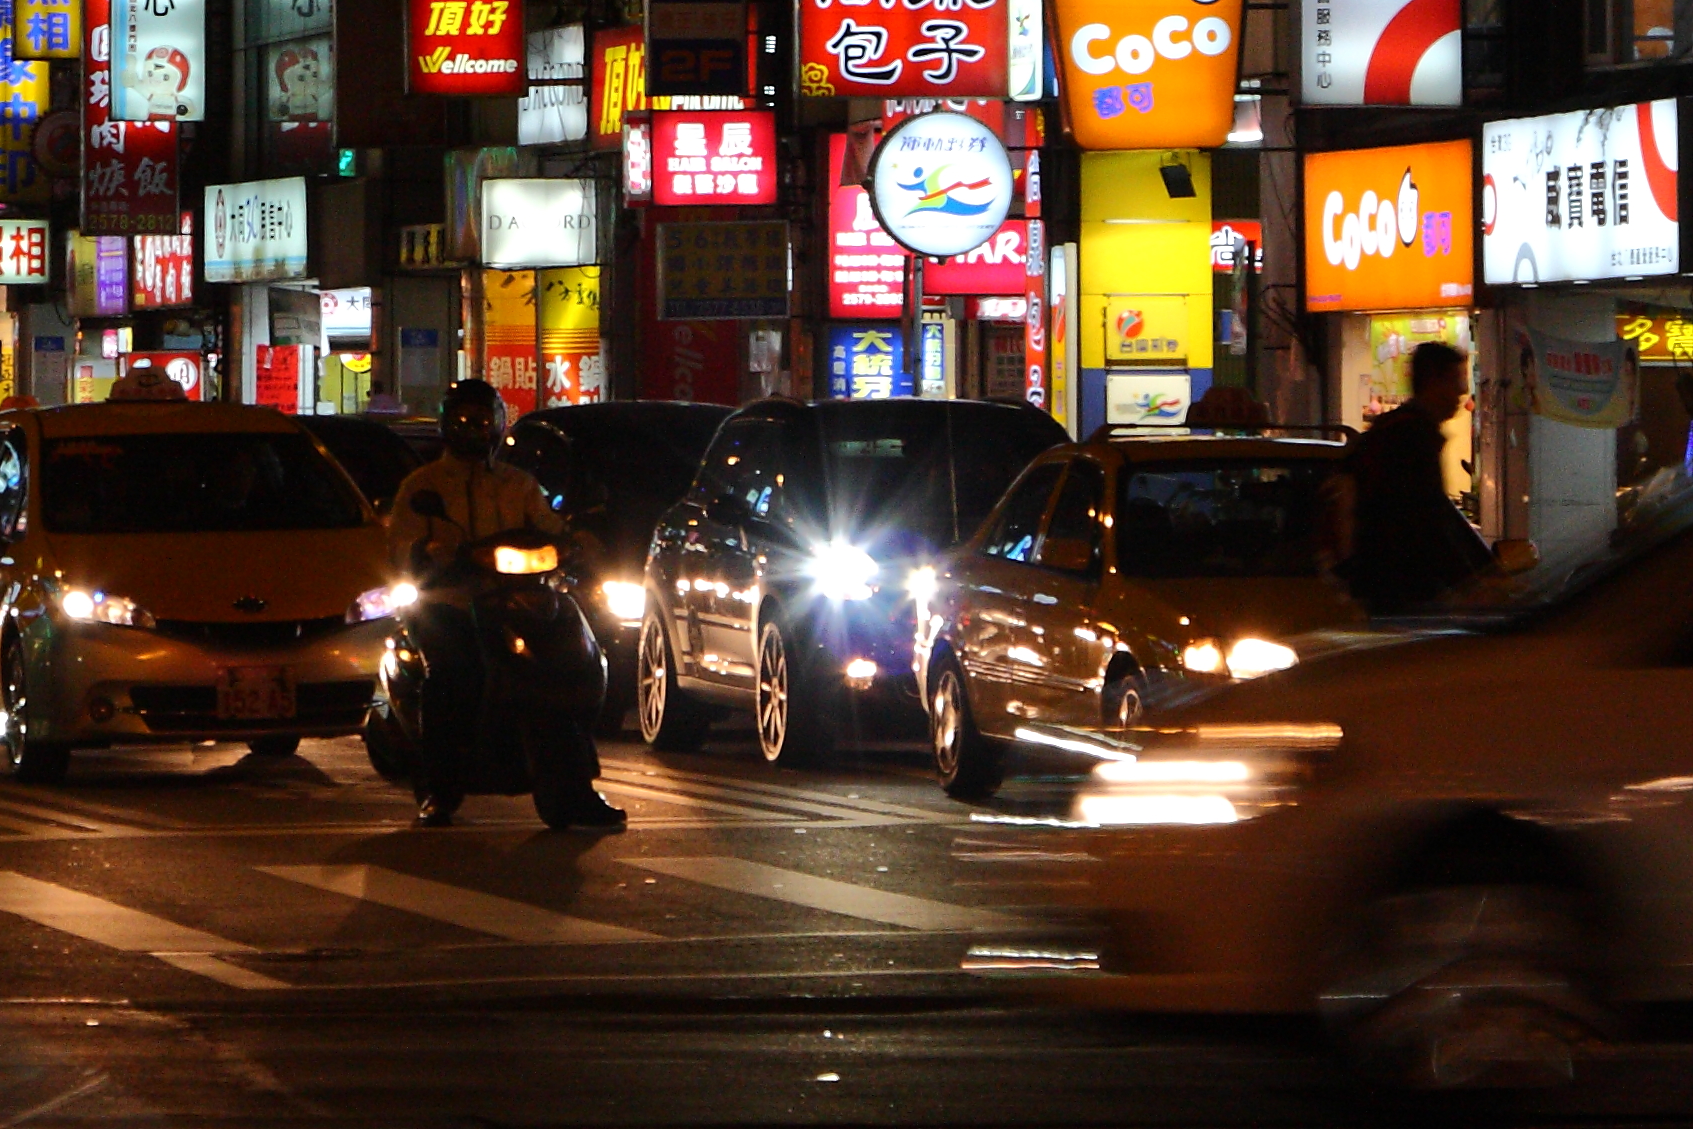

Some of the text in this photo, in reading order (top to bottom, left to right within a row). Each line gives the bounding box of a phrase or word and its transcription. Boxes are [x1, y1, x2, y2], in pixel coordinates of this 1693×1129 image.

[424, 1, 510, 37] 頂好
[1071, 15, 1233, 75] CoCo
[418, 46, 518, 75] Wellcome
[1545, 159, 1631, 231] 威寶電信
[1323, 190, 1397, 271] CoCo
